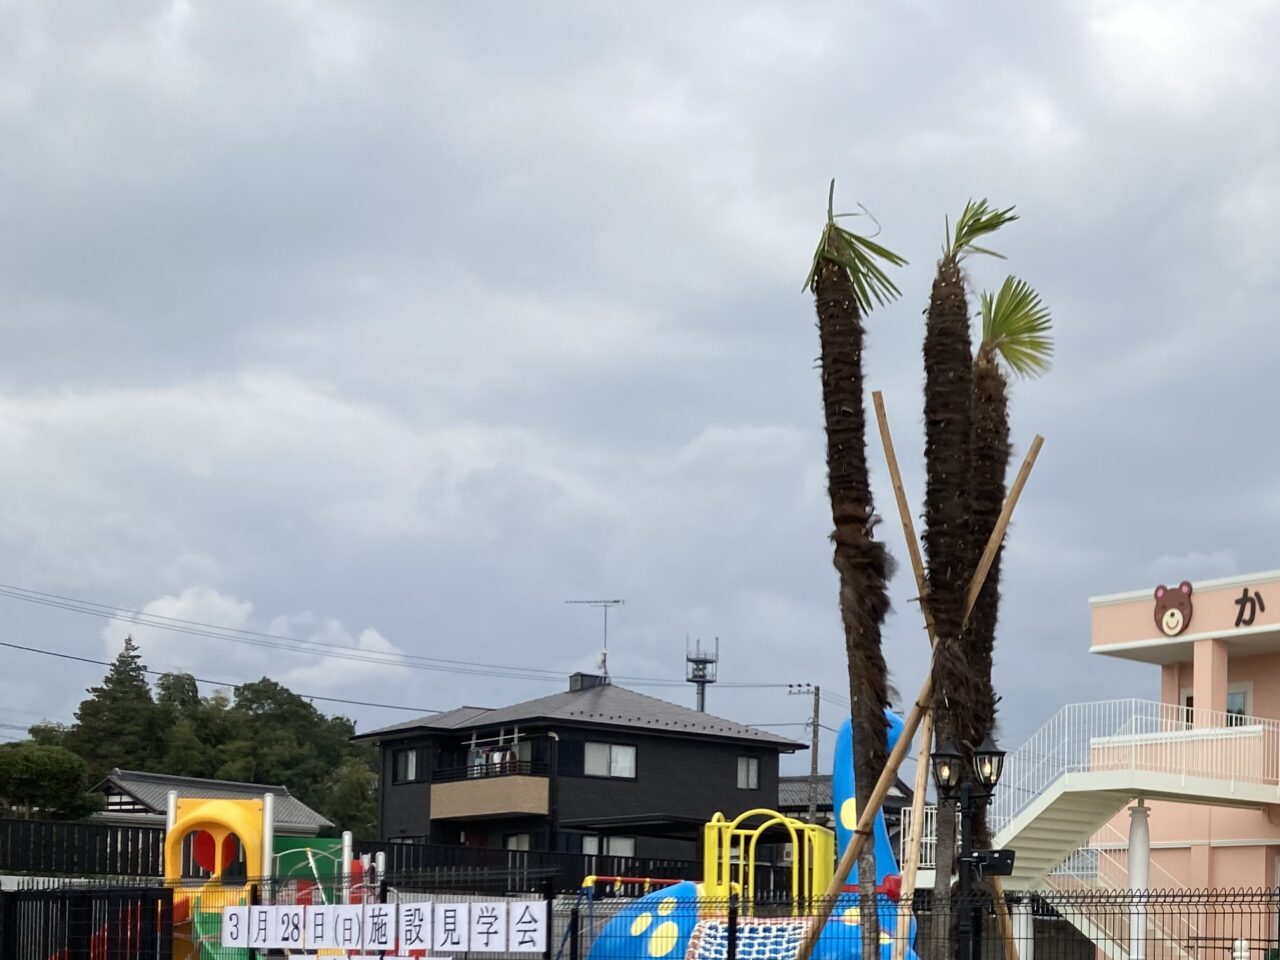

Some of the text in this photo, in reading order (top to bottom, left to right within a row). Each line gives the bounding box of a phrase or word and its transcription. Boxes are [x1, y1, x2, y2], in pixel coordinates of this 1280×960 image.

[229, 905, 538, 948] 3月28日(日)施設見学会
